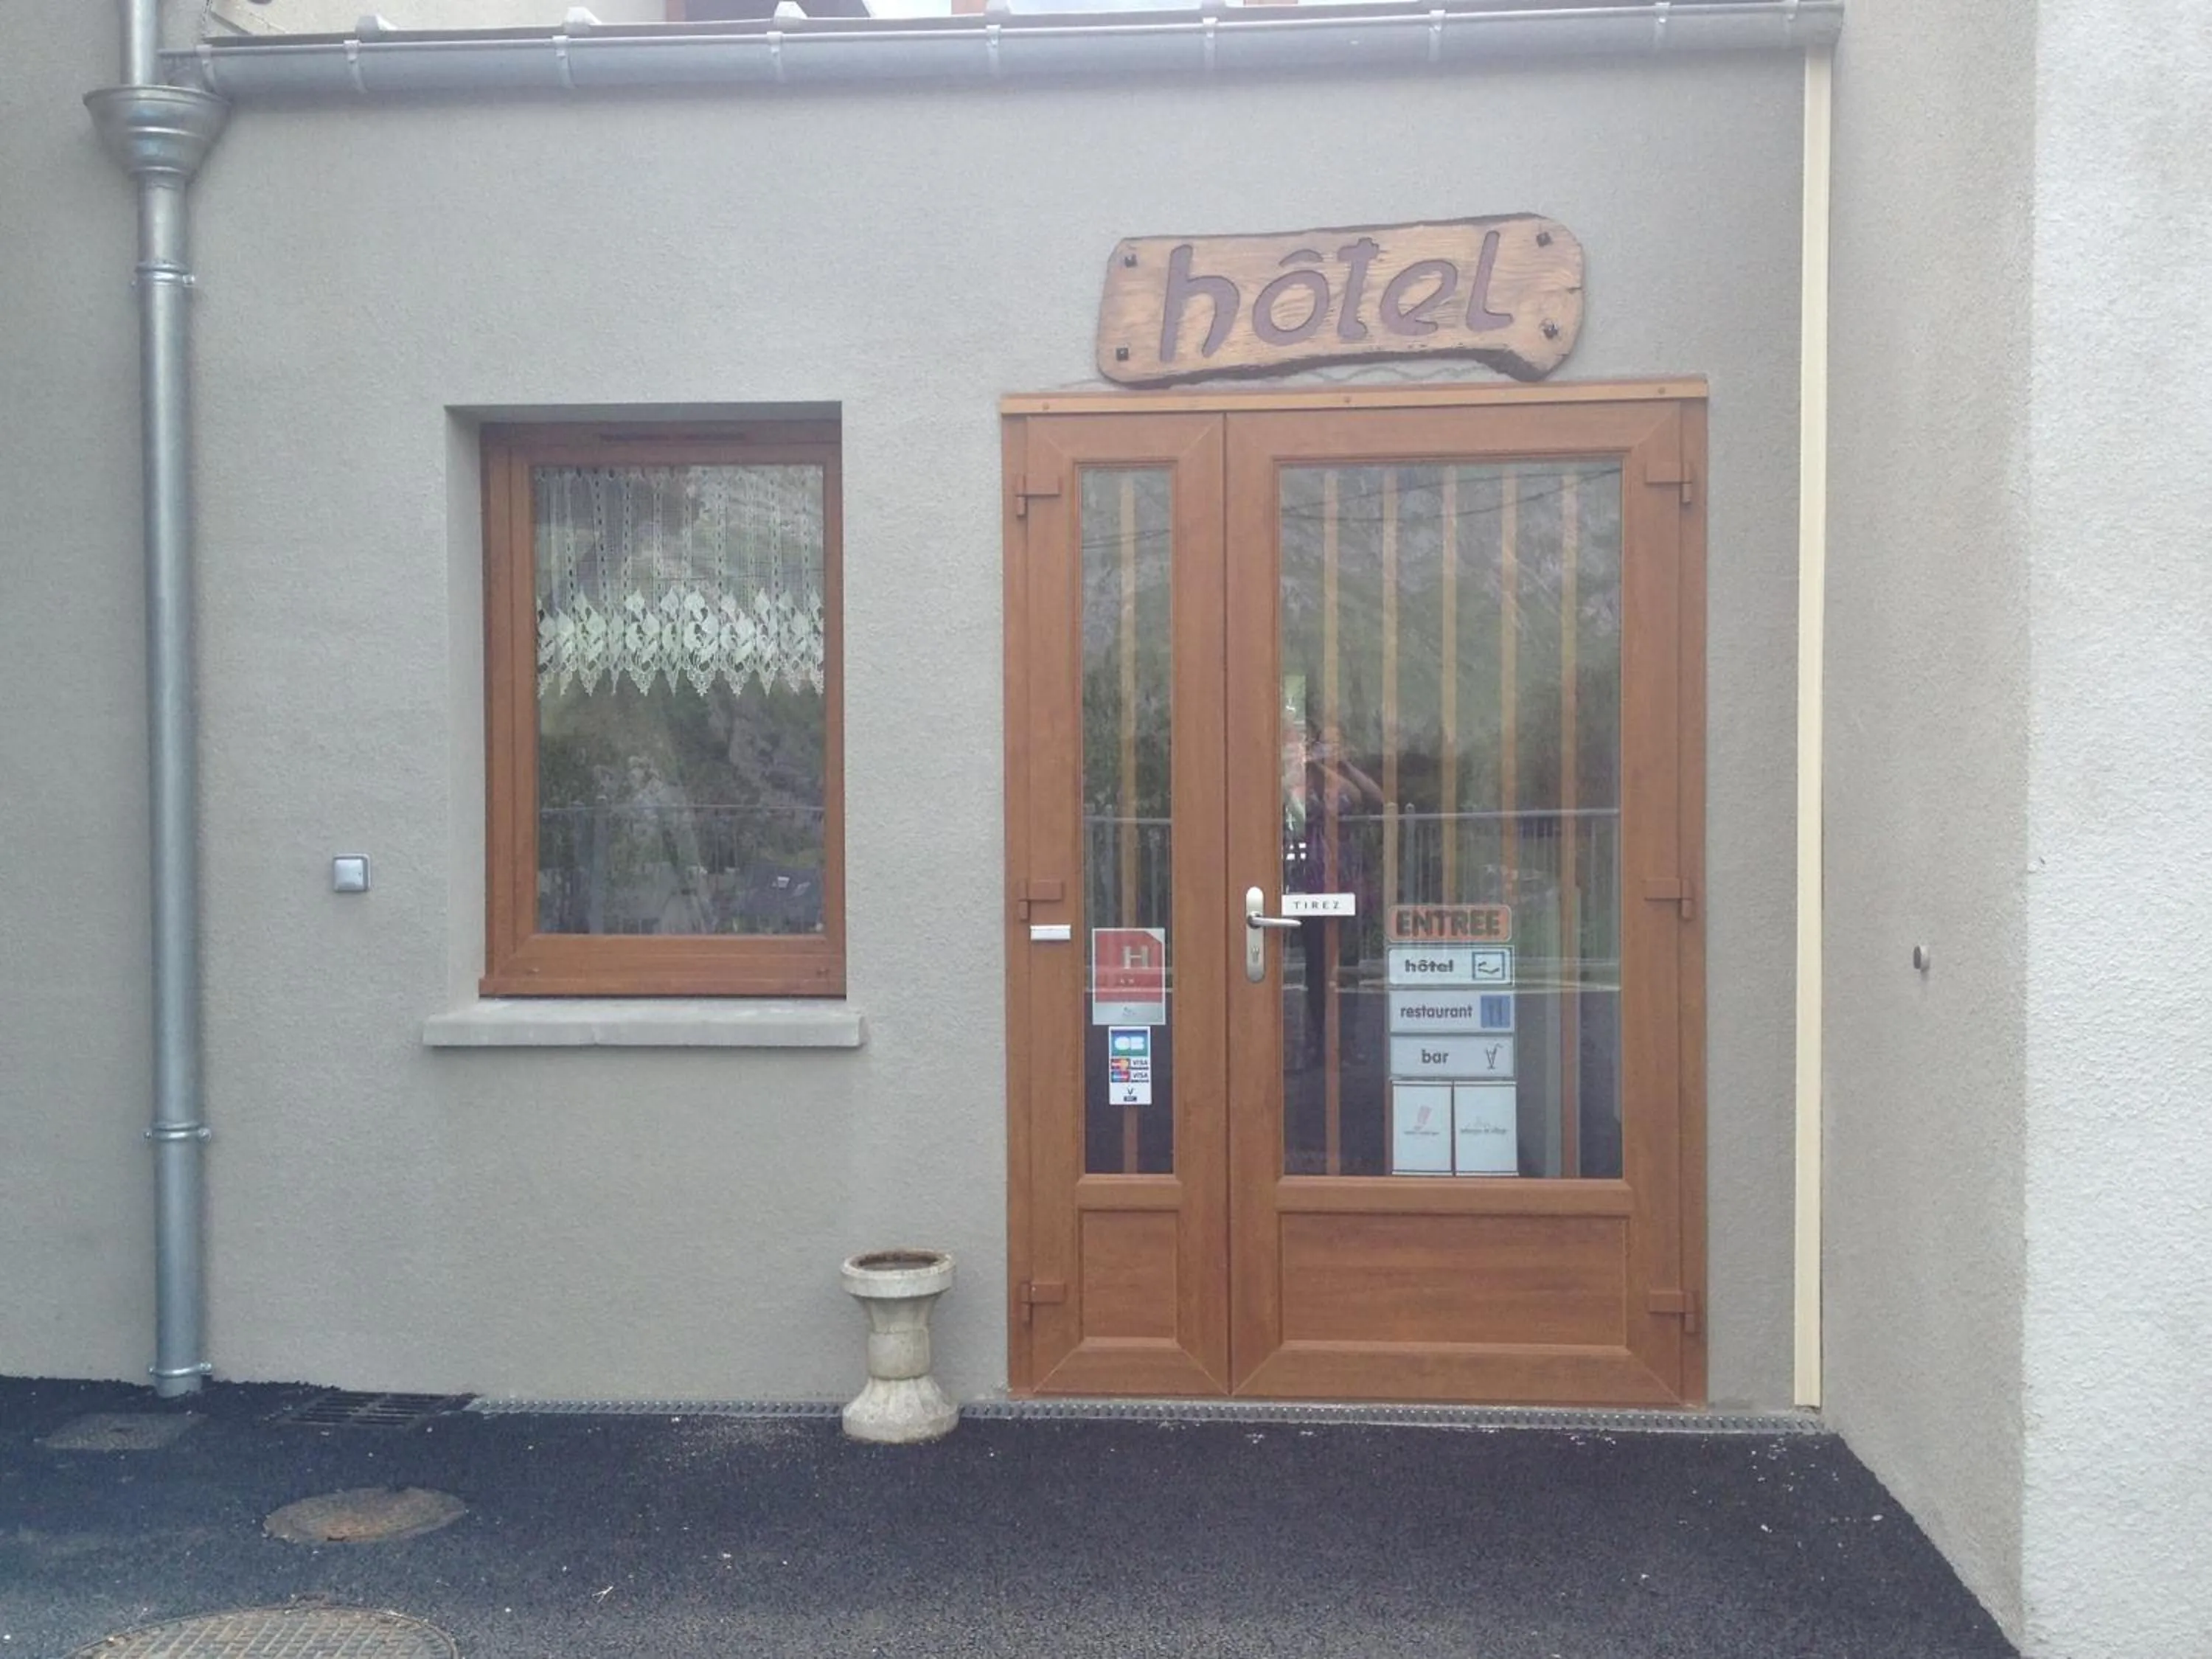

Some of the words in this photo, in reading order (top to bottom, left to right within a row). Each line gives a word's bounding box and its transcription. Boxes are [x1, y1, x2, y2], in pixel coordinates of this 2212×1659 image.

[1160, 230, 1514, 363] hôtel
[1293, 900, 1340, 910] TIREZ
[1396, 910, 1500, 937] ENTREE
[1123, 945, 1149, 970] H
[1405, 959, 1454, 973] hôtel
[1400, 1005, 1473, 1018] restaurant
[1421, 1049, 1449, 1064] bar
